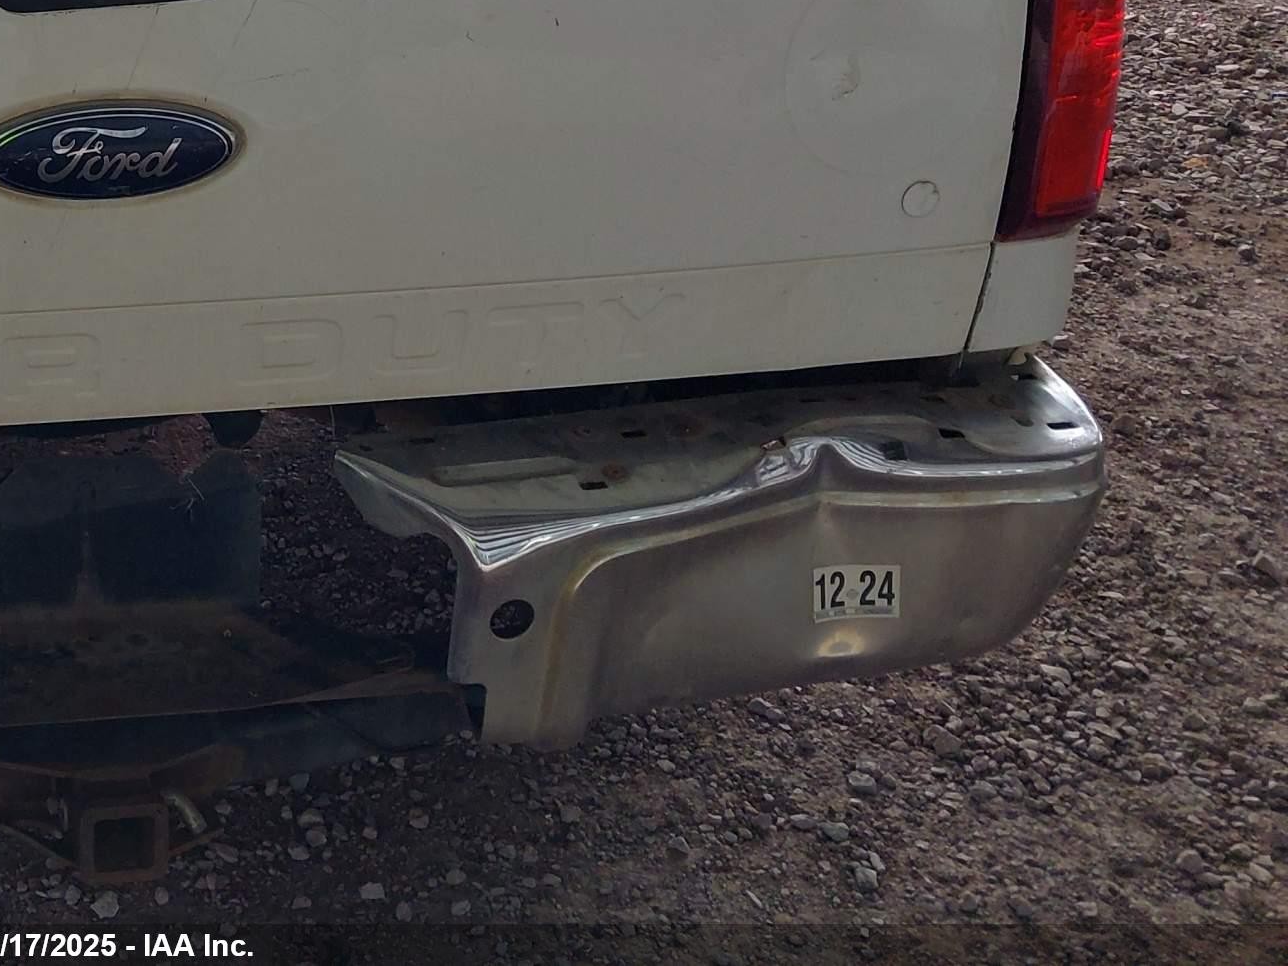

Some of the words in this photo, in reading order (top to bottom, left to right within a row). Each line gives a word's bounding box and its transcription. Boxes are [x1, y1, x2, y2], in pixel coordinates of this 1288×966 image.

[36, 126, 183, 182] Ford
[232, 290, 688, 388] DUTY
[815, 571, 846, 611] 12
[859, 569, 896, 607] 24
